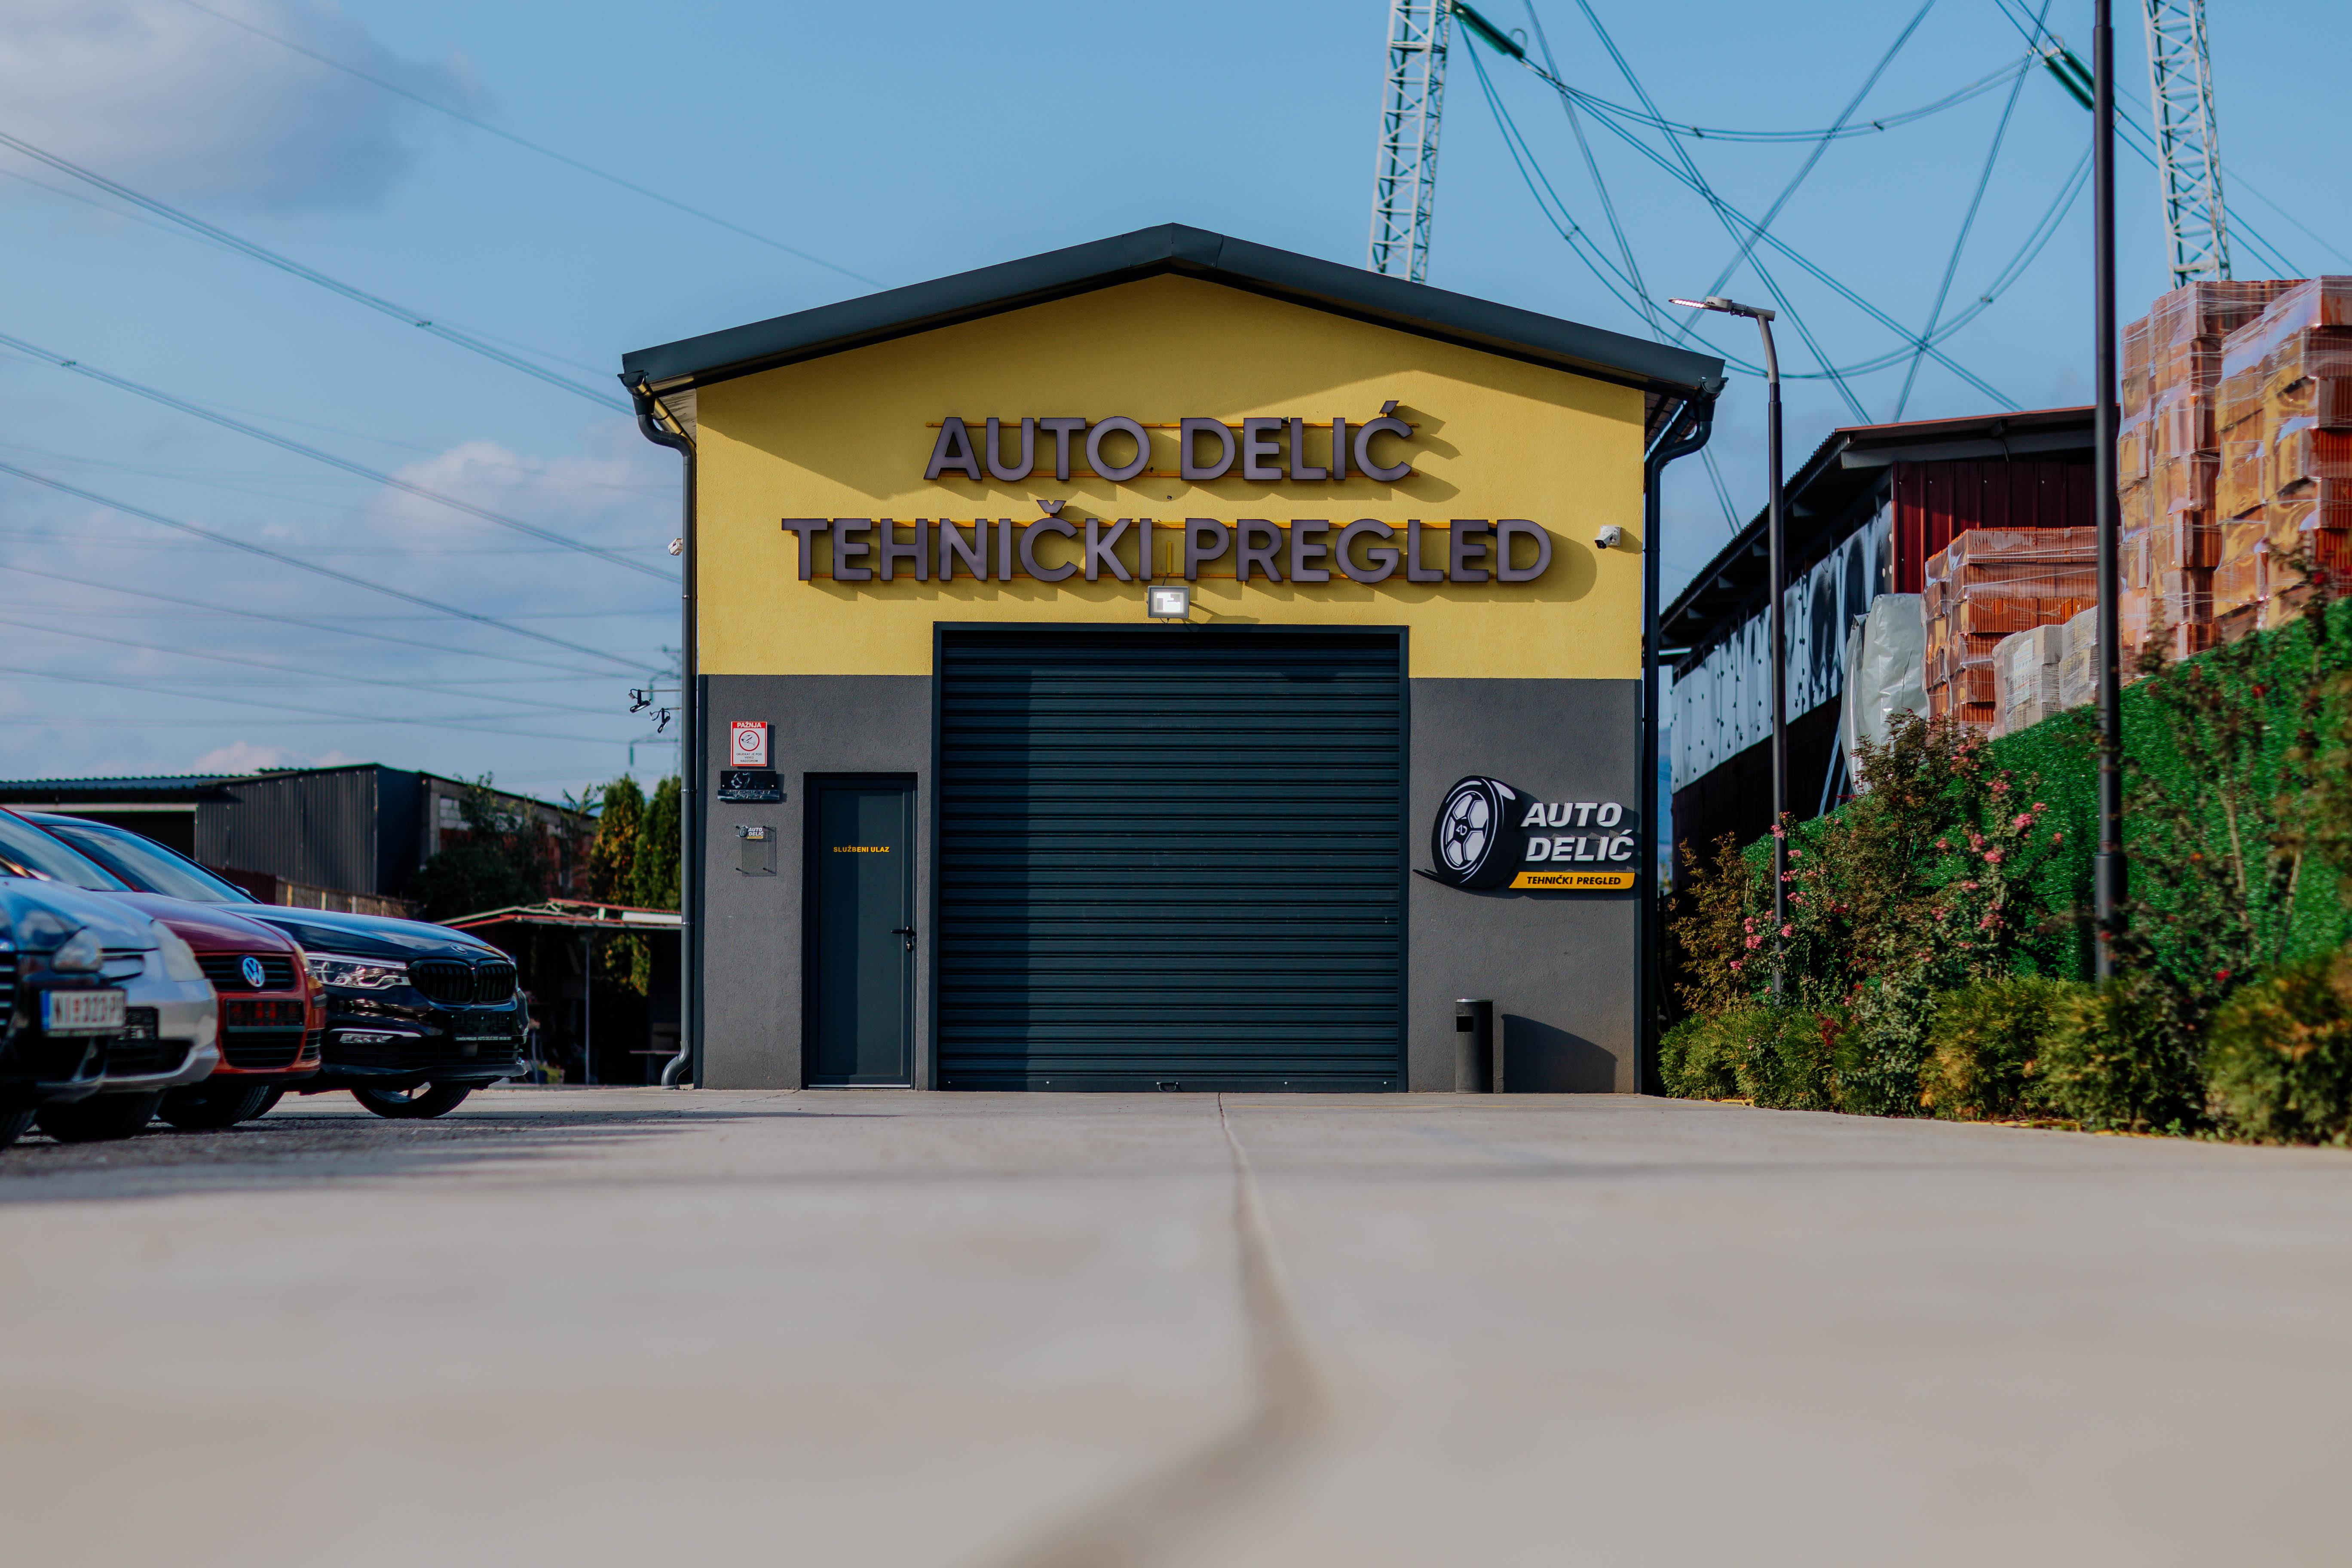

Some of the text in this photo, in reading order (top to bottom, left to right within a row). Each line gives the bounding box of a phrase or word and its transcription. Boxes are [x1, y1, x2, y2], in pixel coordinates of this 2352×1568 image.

[923, 400, 1414, 481] AUTO DELIĆ
[781, 499, 1552, 584] TEHNIČKI PREGLED
[1520, 802, 1623, 827] AUTO
[1525, 829, 1635, 861] DELIĆ
[1527, 875, 1621, 885] TEHNIČKI PREGLED
